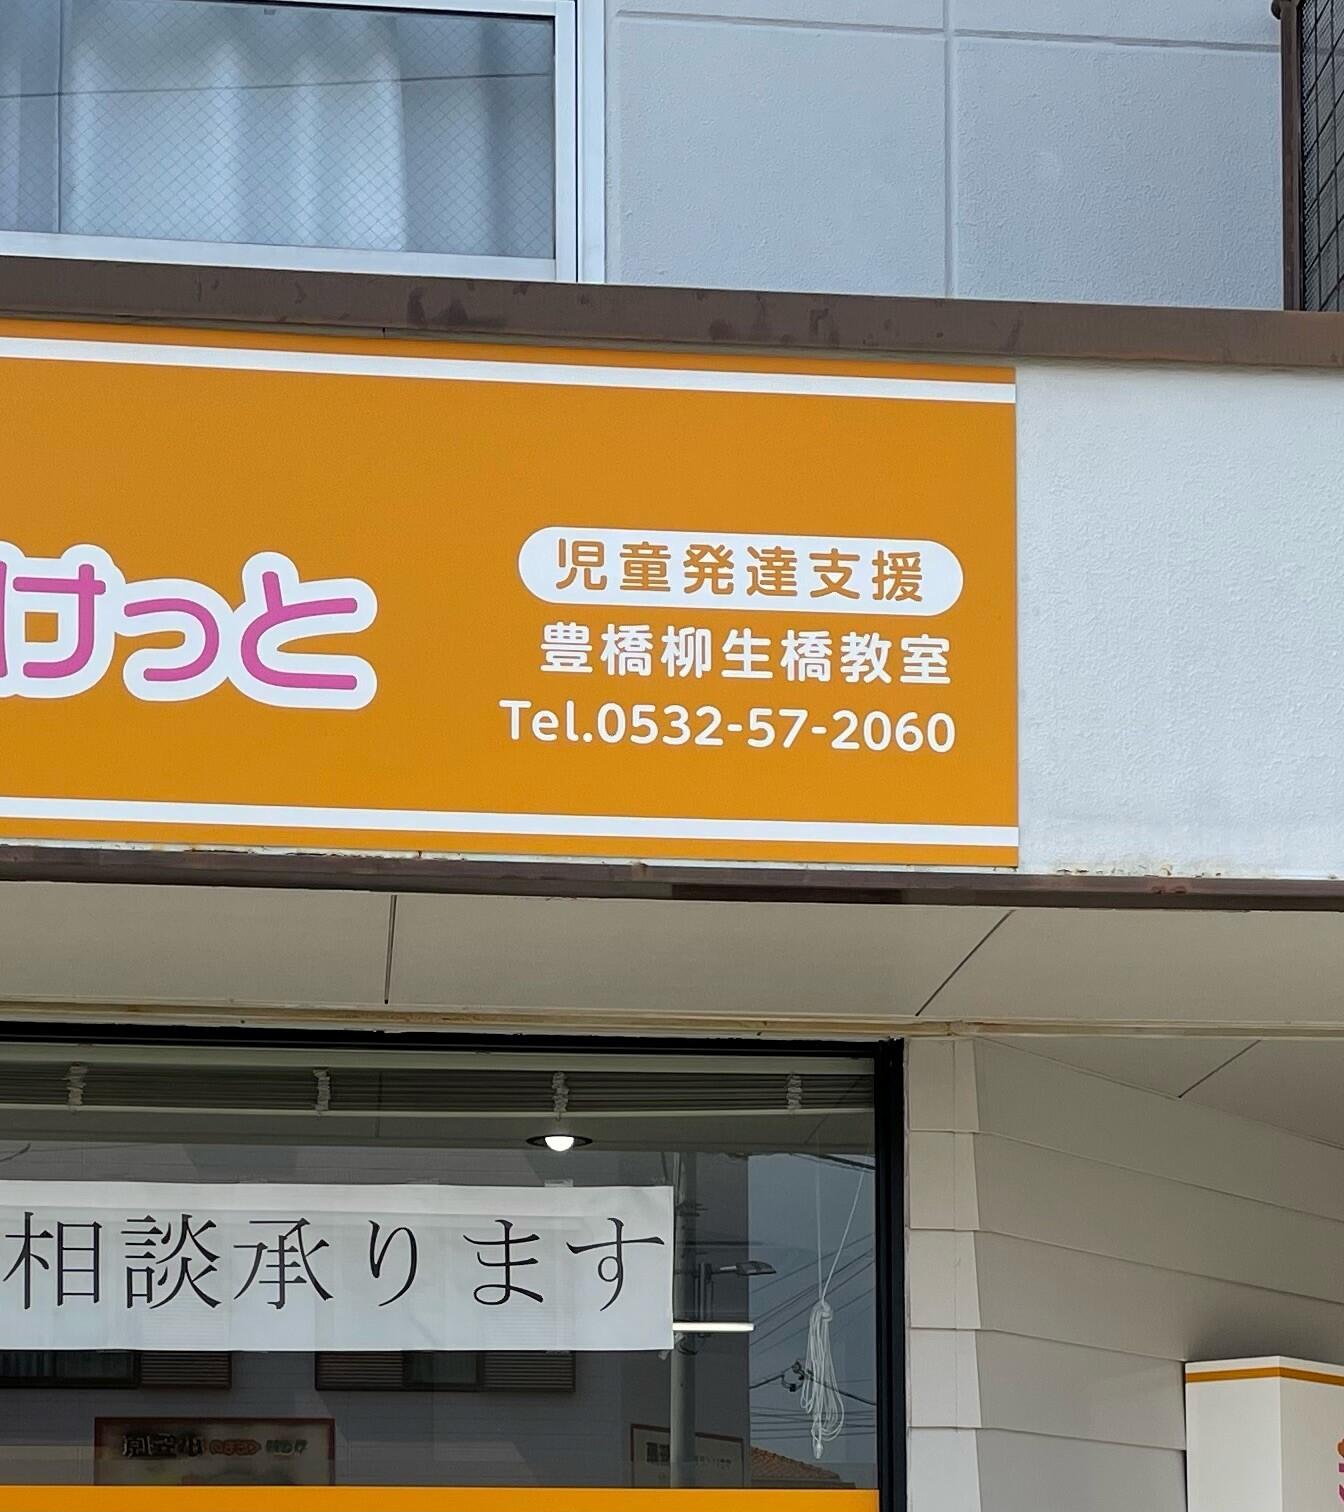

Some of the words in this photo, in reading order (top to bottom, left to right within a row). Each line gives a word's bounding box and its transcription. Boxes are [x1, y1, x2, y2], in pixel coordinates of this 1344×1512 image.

[555, 537, 923, 604] 児童発達支援
[539, 621, 952, 685] 豊橋柳生橋教室
[499, 699, 957, 753] Tel.0532-57-2060
